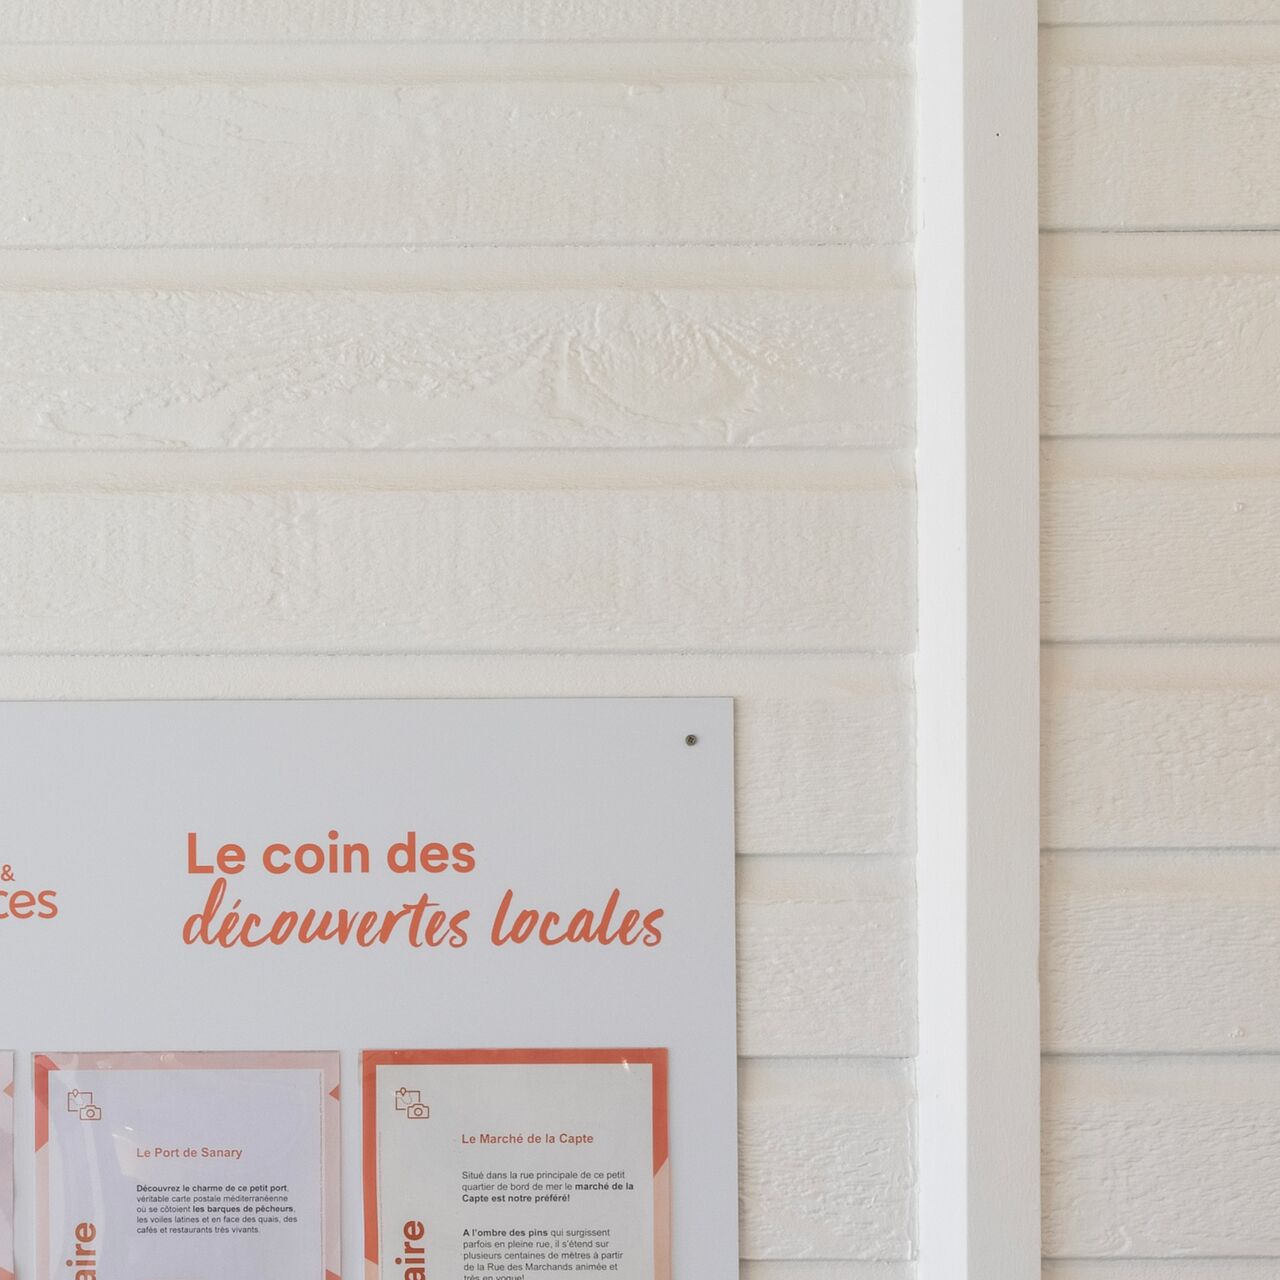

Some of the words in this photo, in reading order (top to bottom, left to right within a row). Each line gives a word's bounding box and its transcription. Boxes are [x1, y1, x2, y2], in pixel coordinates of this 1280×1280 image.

[188, 833, 246, 874] Le
[263, 830, 369, 874] coin
[387, 832, 475, 873] des
[181, 877, 468, 949] découvertes
[490, 888, 664, 949] locales
[462, 1135, 476, 1143] Le
[480, 1134, 523, 1143] Marché
[527, 1134, 541, 1143] de
[546, 1134, 555, 1143] la
[560, 1134, 593, 1145] Capte
[137, 1148, 150, 1157] Le
[155, 1148, 179, 1157] Port
[183, 1148, 197, 1157] de
[201, 1148, 242, 1159] Sanary
